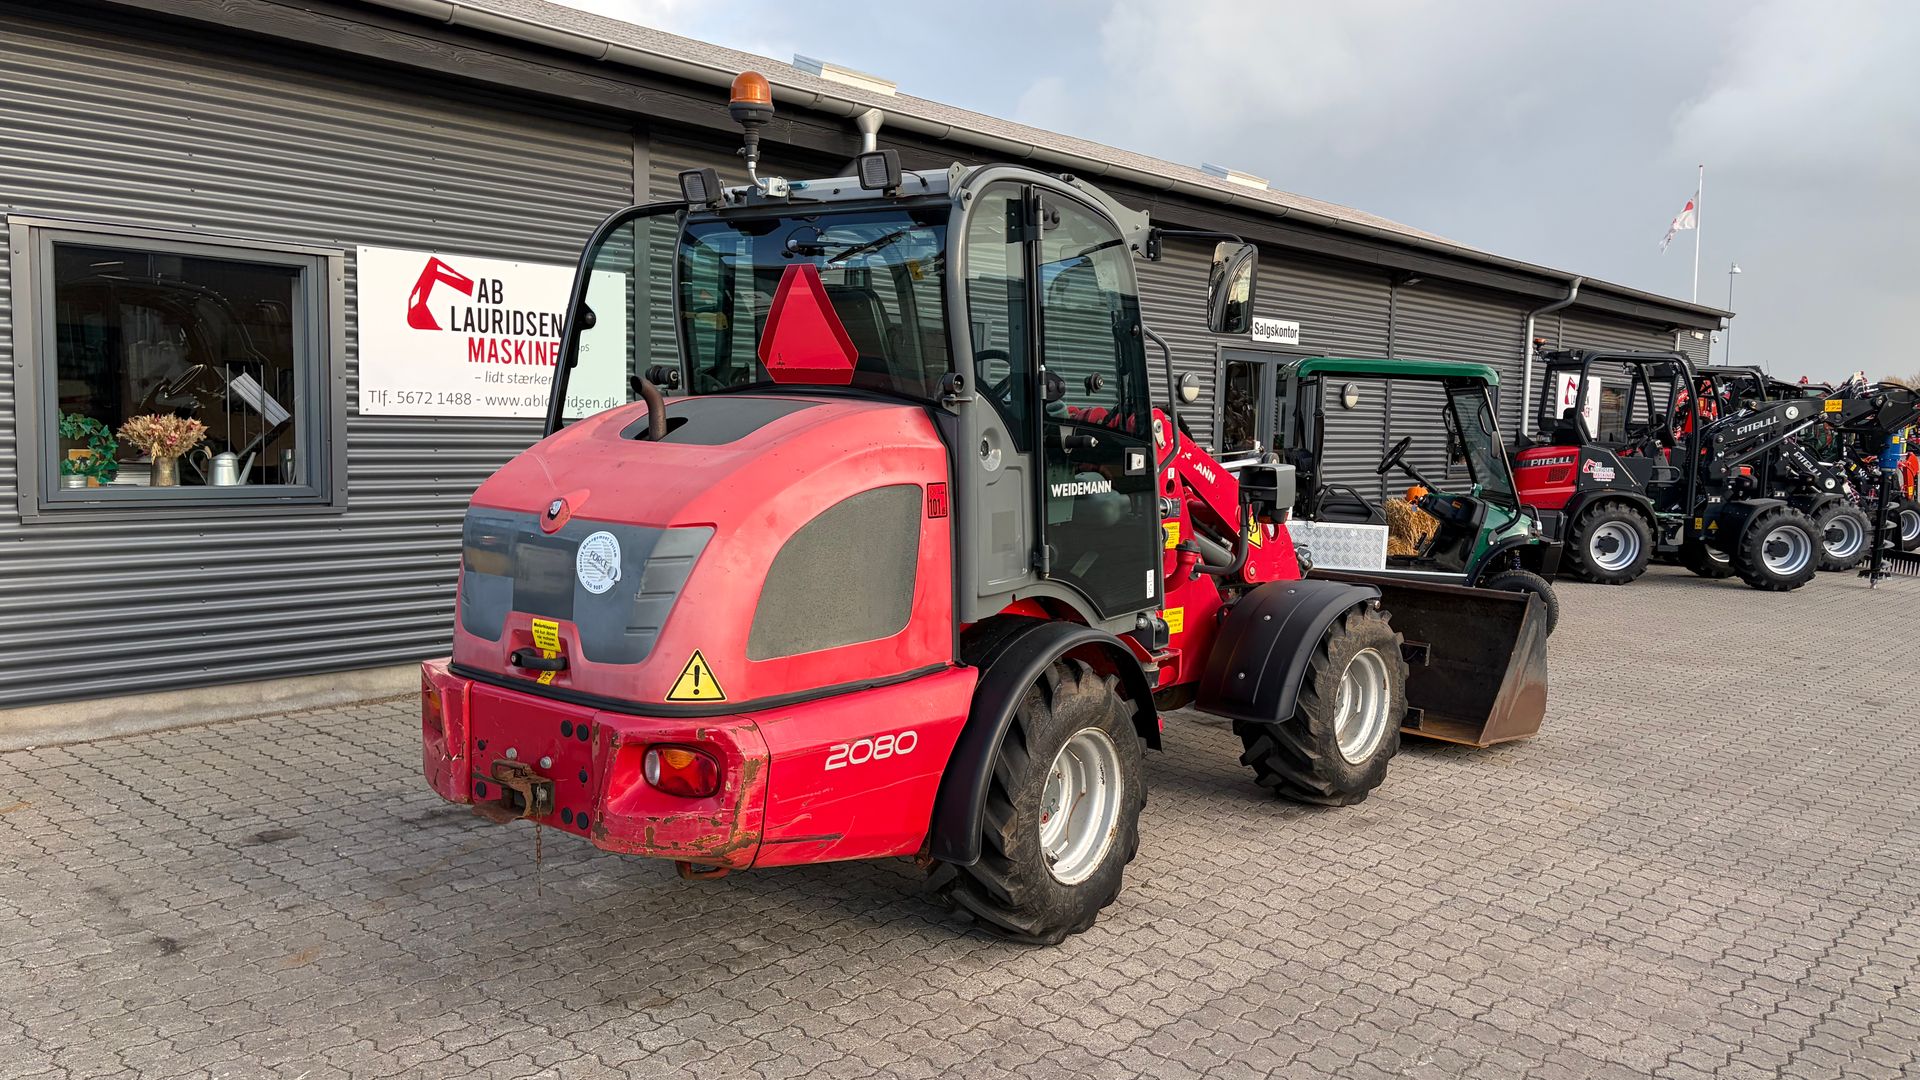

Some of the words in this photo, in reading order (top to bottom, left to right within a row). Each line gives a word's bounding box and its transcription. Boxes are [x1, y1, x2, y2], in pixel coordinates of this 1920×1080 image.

[477, 278, 504, 305] AB
[451, 305, 563, 338] LAURIDSEN
[1254, 321, 1298, 339] Salgskontor
[468, 337, 560, 367] MASKINE
[579, 344, 590, 353] pS
[485, 371, 504, 384] lidt
[368, 390, 392, 407] Tlf.
[396, 391, 433, 405] 5672
[437, 392, 472, 406] 1488
[485, 394, 620, 409] www.ablaidsen.dk
[1737, 416, 1779, 436] PITBULL
[1531, 456, 1572, 467] PITBULL
[1793, 451, 1822, 477] PITBULL
[1051, 480, 1112, 498] WEIDEMANN
[589, 550, 608, 570] FORCE
[824, 730, 918, 771] 2080
